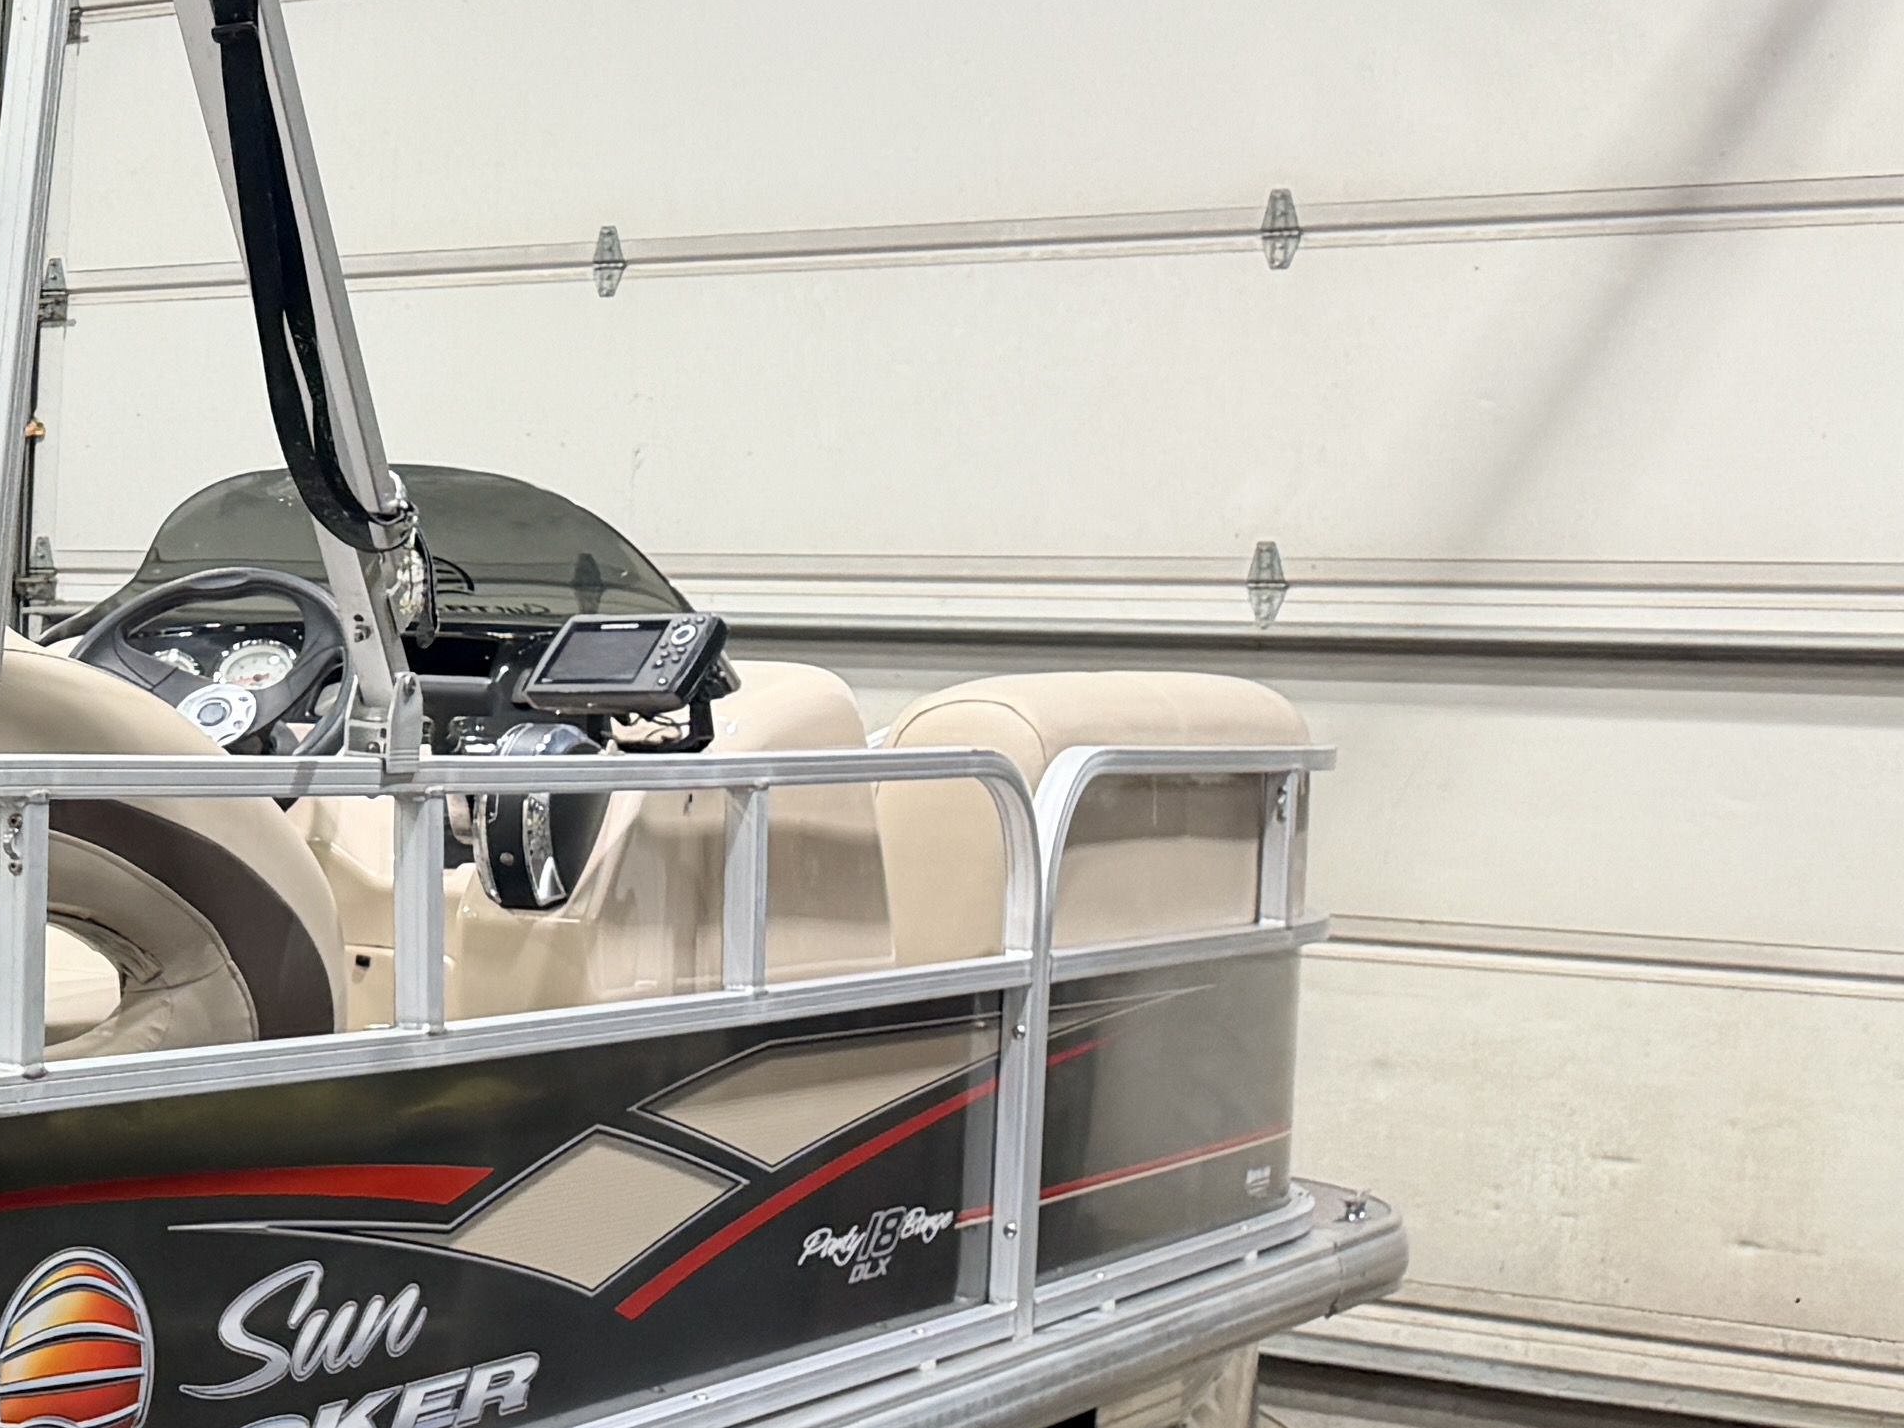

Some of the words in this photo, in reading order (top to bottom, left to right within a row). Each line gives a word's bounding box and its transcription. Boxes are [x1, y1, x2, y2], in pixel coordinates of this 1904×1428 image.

[797, 1225, 866, 1267] Party
[856, 1206, 907, 1261] 18
[848, 1255, 891, 1285] DLX
[179, 1260, 428, 1400] Sun
